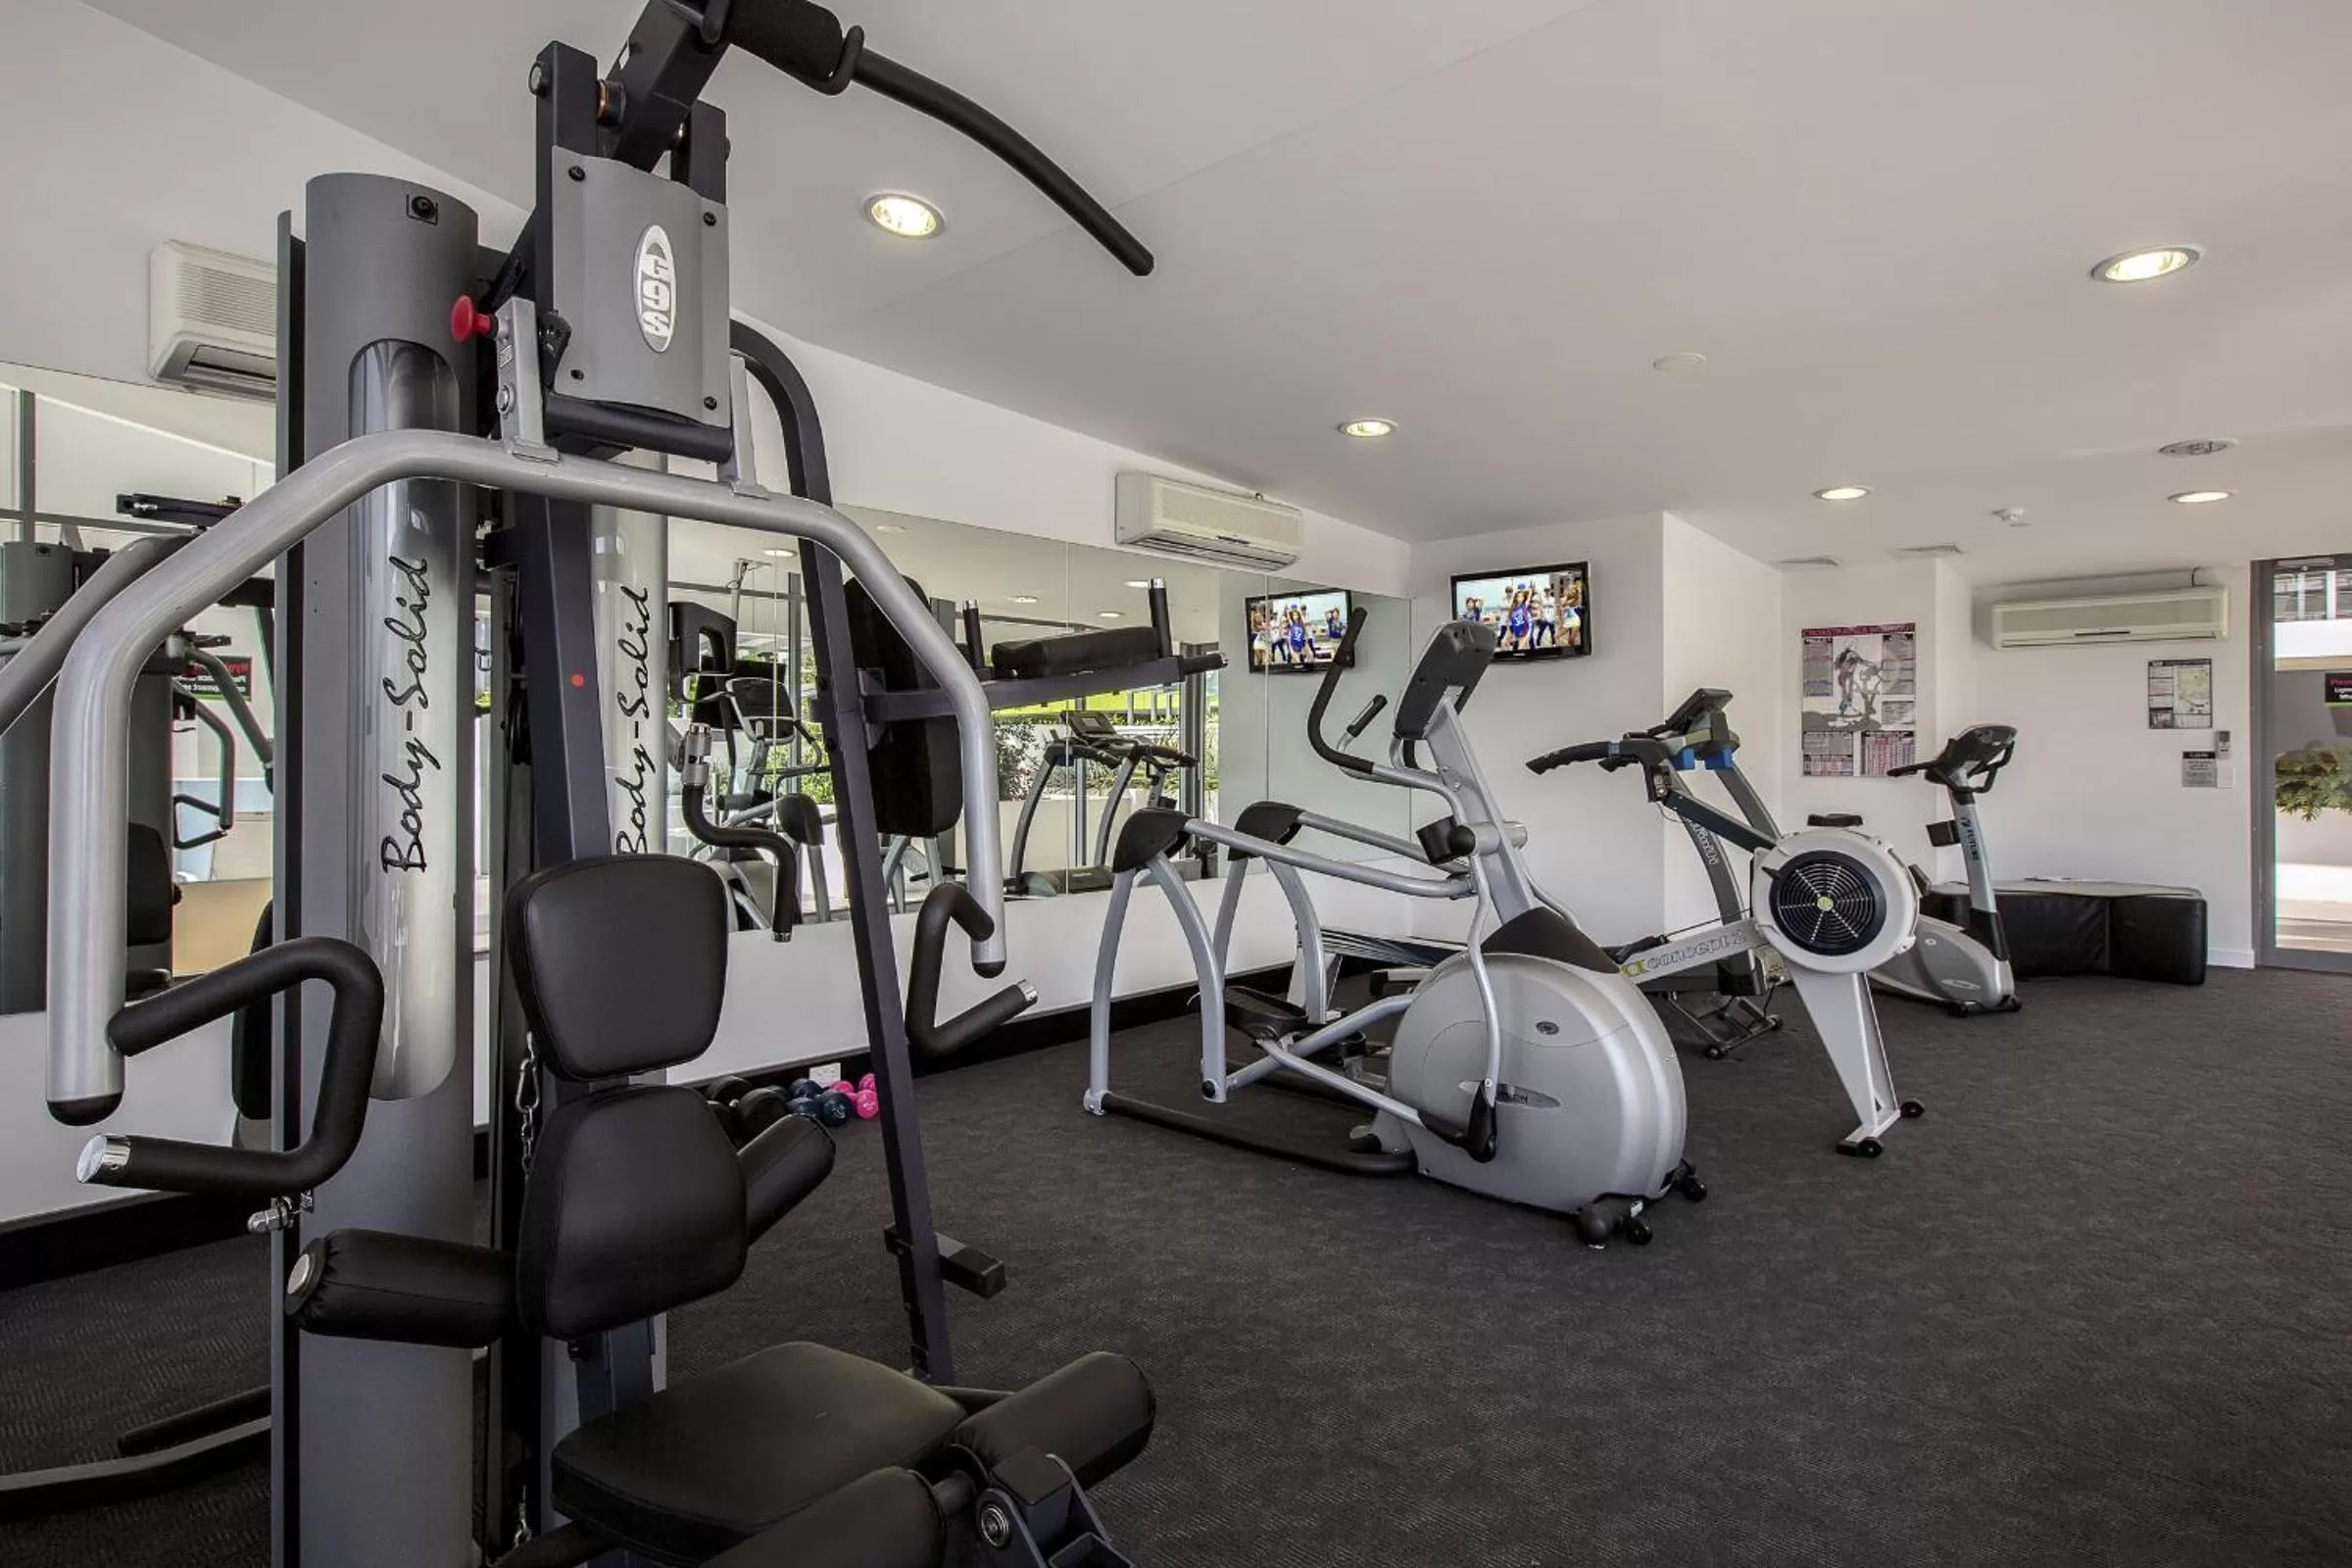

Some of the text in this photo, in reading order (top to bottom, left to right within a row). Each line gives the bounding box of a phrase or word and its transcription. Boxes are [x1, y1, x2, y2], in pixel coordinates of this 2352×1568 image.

[380, 556, 441, 874] Body-Solid
[615, 585, 656, 855] Body-Solid
[1646, 936, 1729, 970] concept
[1732, 929, 1745, 944] 2
